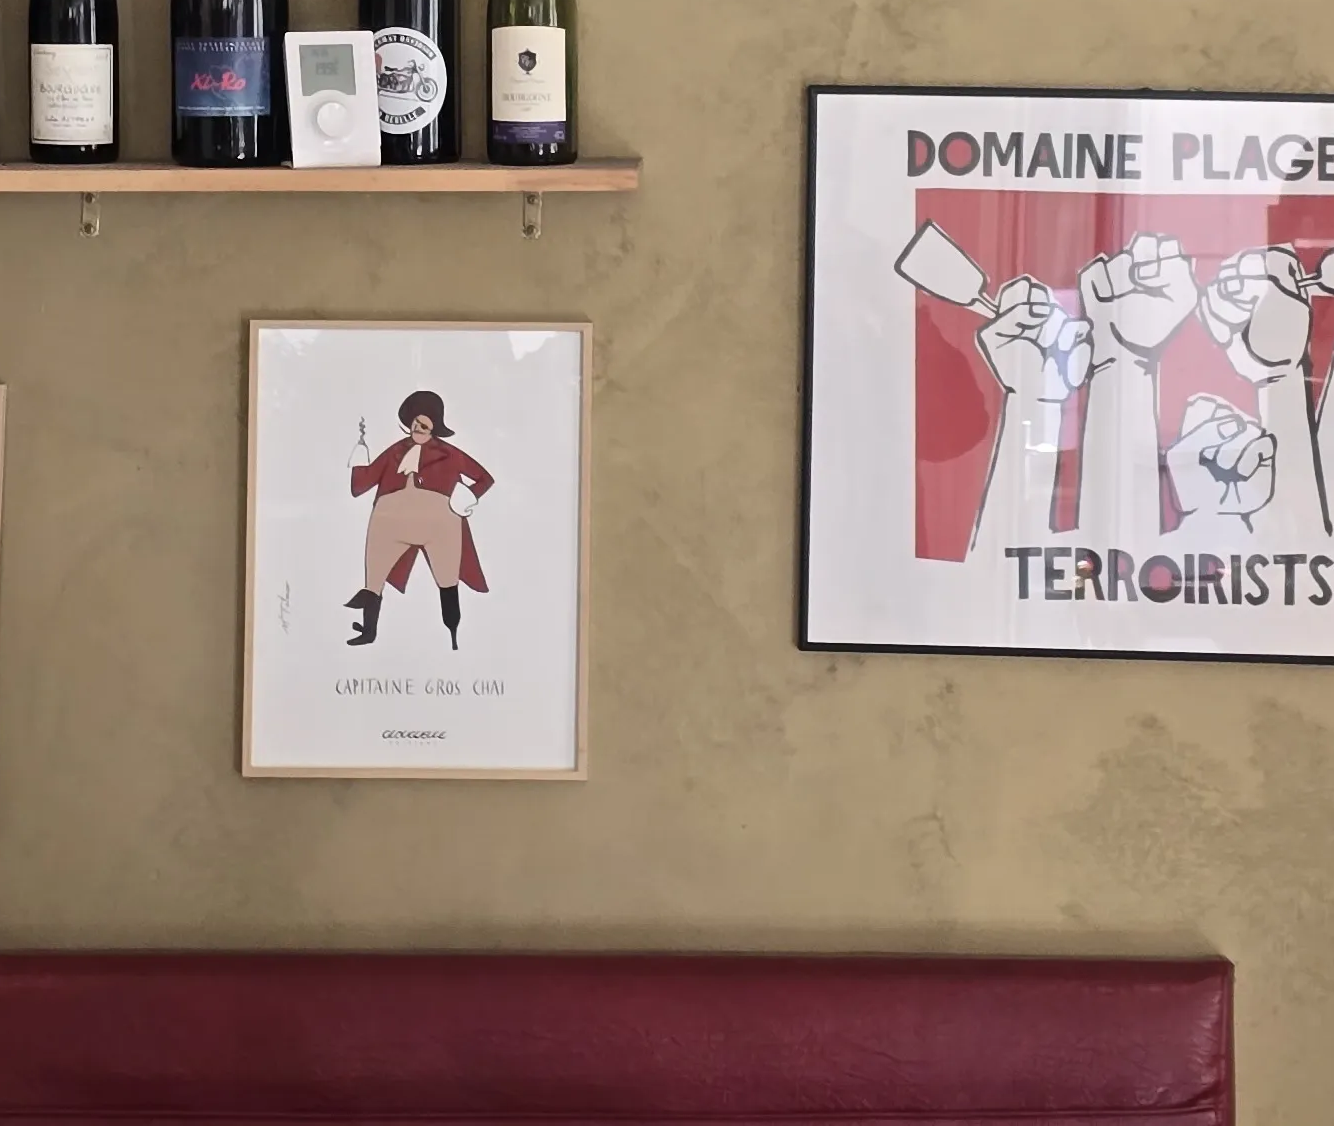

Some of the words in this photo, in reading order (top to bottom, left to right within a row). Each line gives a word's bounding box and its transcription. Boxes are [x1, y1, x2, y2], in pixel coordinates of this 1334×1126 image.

[907, 129, 1143, 180] DOMAINE
[1005, 547, 1334, 606] TERROIRISTS
[335, 677, 415, 696] CAPITAINE
[425, 678, 462, 696] GROS
[472, 678, 506, 696] CHAI
